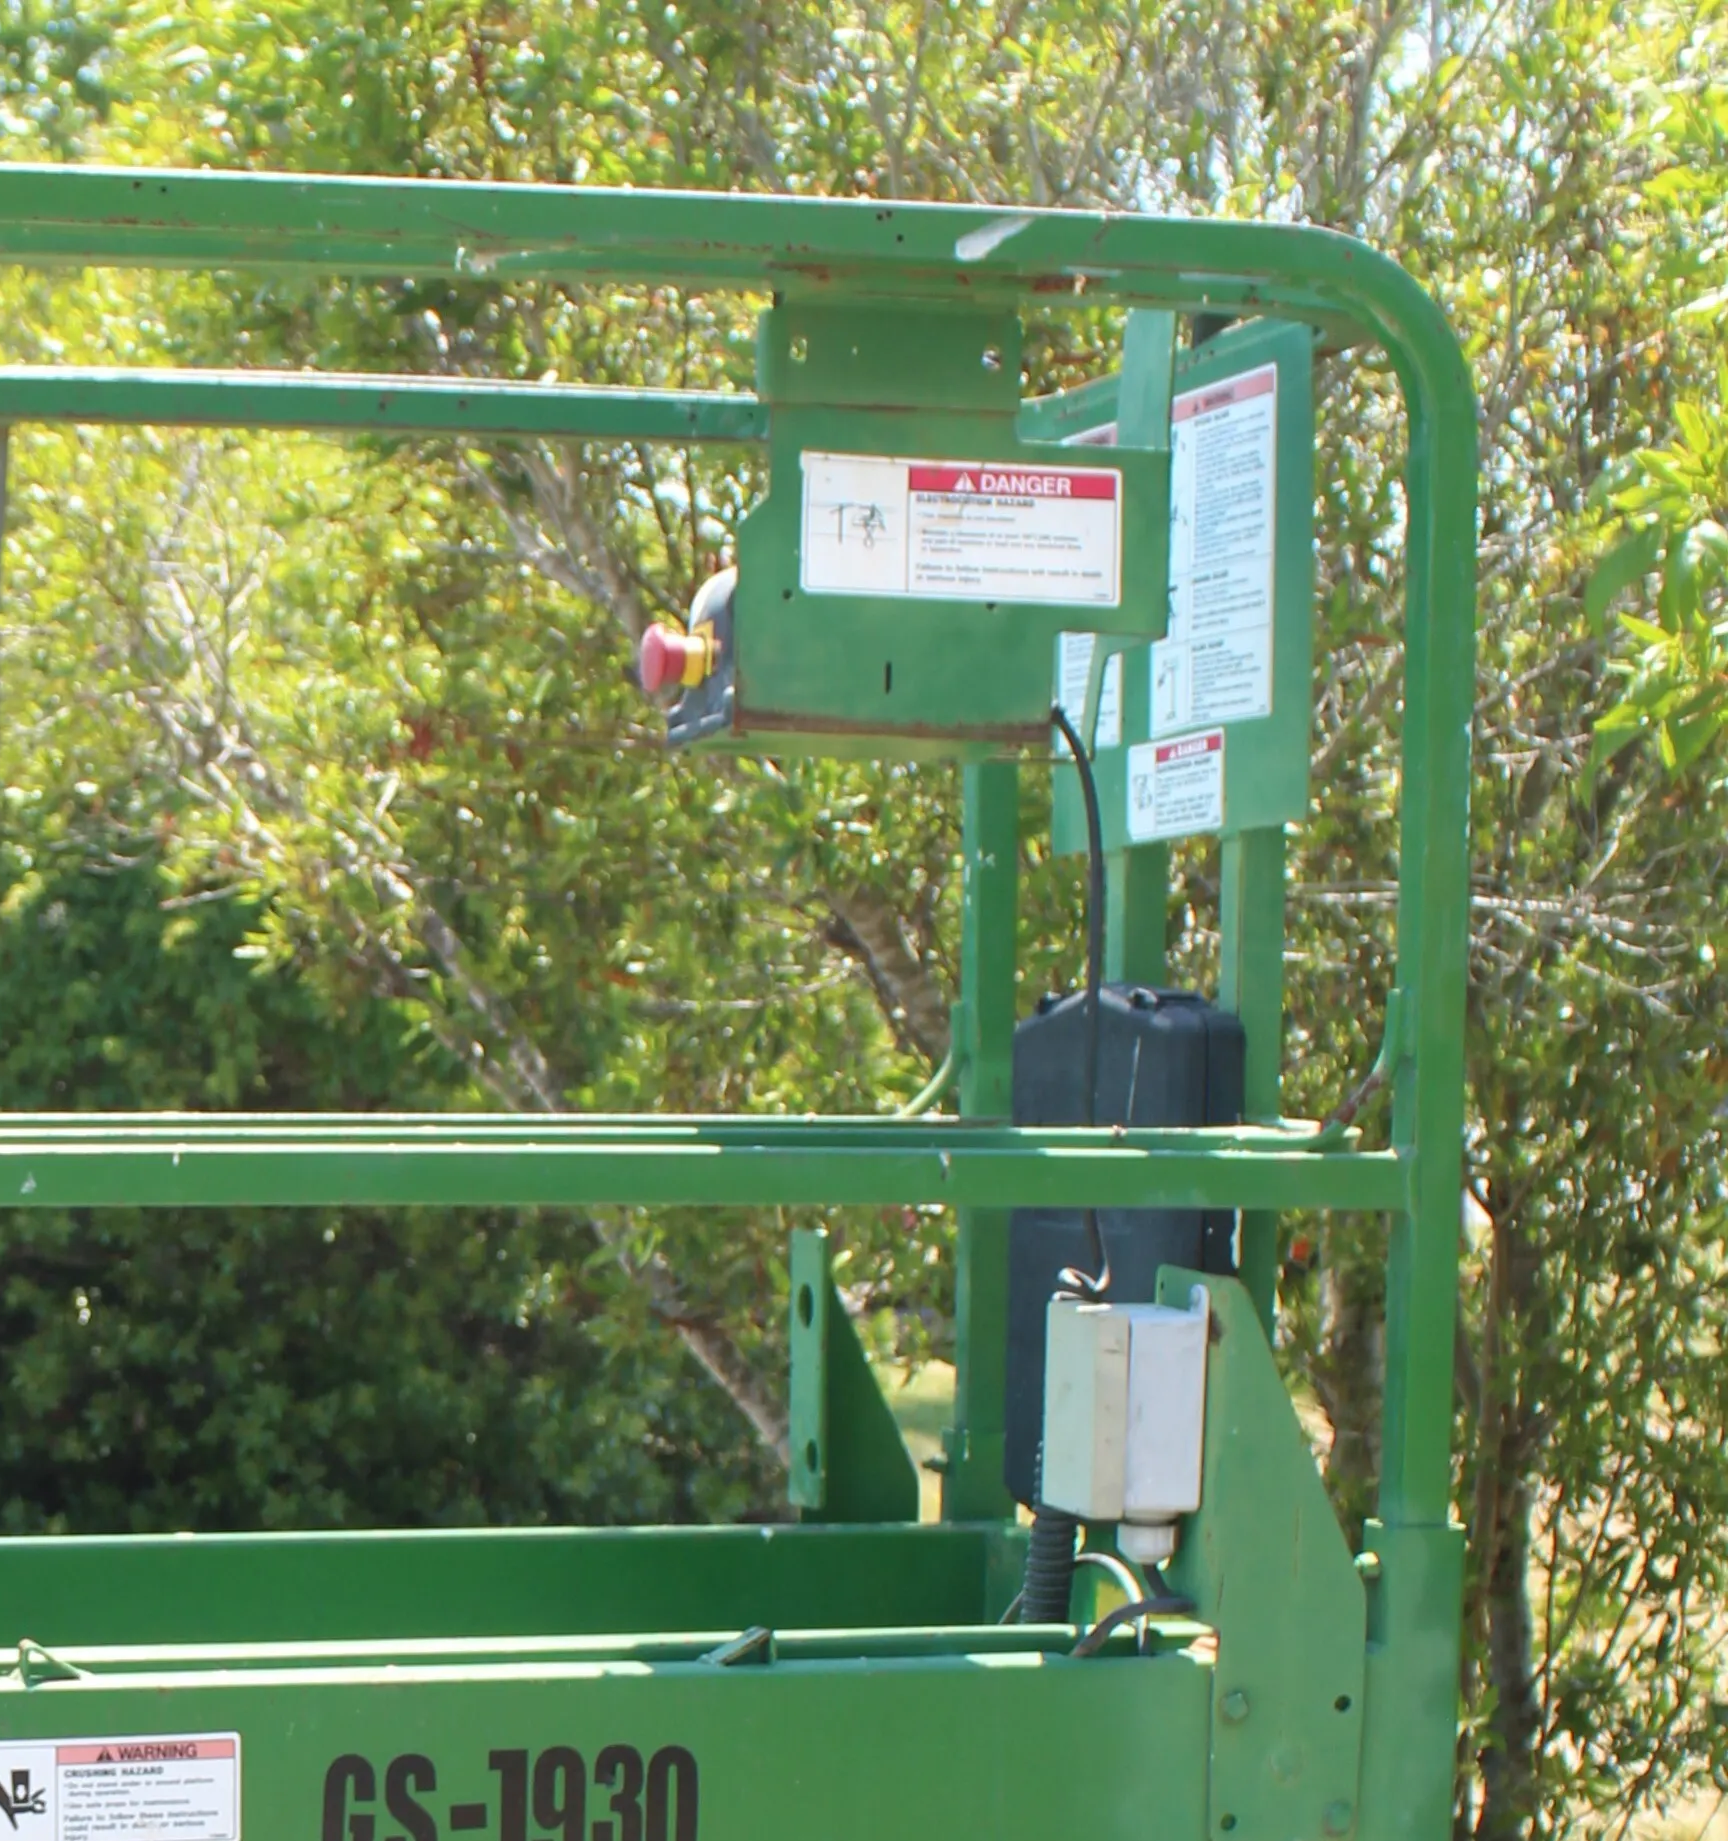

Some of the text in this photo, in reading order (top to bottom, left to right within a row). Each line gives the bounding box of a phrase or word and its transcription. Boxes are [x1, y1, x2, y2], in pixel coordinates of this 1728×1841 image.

[980, 474, 1072, 495] DANGER
[118, 1743, 198, 1761] WARNING
[64, 1766, 164, 1778] CRUSHING HAZARD
